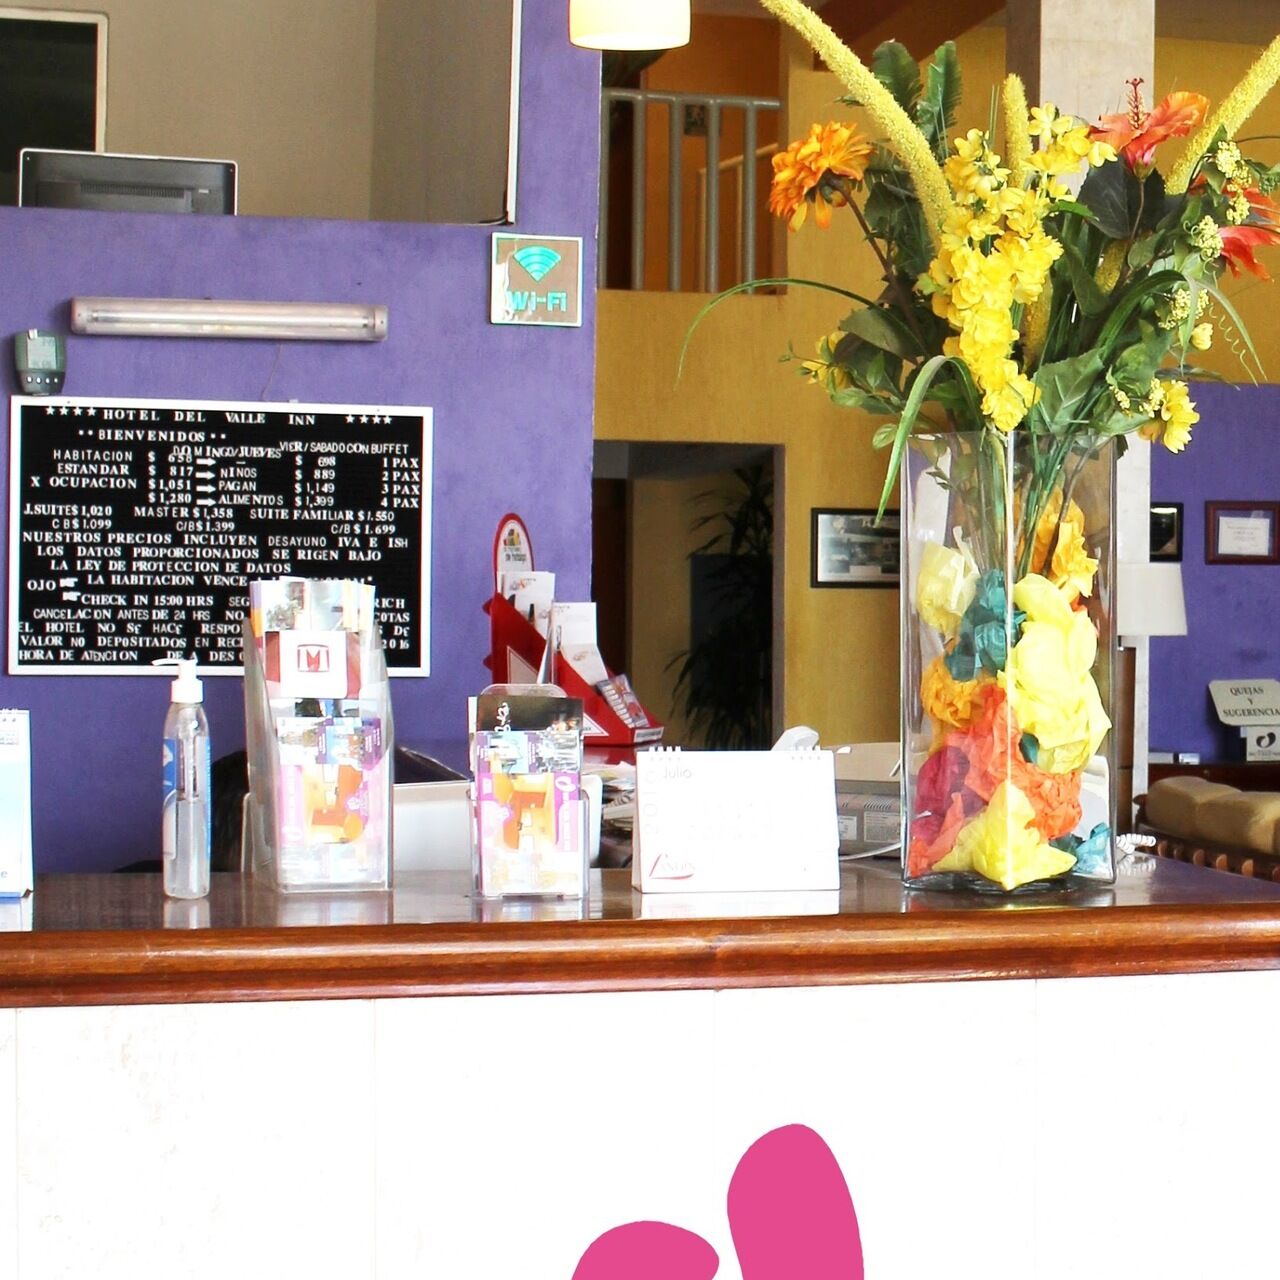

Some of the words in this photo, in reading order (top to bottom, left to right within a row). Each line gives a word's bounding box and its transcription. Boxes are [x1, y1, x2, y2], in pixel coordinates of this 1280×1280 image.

[104, 408, 159, 420] HOTEL
[175, 411, 205, 422] DEL
[226, 411, 265, 423] VALLE
[289, 414, 314, 425] INN
[368, 444, 408, 454] BUFFET
[54, 450, 132, 461] HABITACION
[393, 458, 418, 468] PAX
[58, 463, 129, 475] ESTANDAR
[170, 466, 193, 476] 817
[314, 470, 335, 479] 889
[382, 471, 388, 481] 2
[393, 471, 419, 481] PAX
[32, 476, 40, 487] X
[50, 477, 136, 488] OCUPACION
[219, 481, 256, 491] PAGAN
[382, 484, 388, 494] 3
[393, 485, 419, 495] PAX
[219, 494, 283, 505] ALIMENTOS
[381, 497, 388, 507] 4
[394, 498, 418, 508] PAX
[135, 507, 189, 517] MASTER
[251, 508, 288, 519] SUITE
[294, 510, 353, 520] FAMILIAR
[23, 531, 101, 542] NUESTROS
[108, 533, 171, 544] PRECIOS
[184, 534, 256, 545] INCLUYEN
[269, 536, 326, 547] DESAYUNO
[339, 537, 360, 547] IVA
[370, 537, 377, 547] E
[389, 538, 408, 547] ISH
[38, 546, 63, 556] LOS
[78, 546, 121, 557] DATOS
[134, 547, 259, 559] PROPORCIONADOS
[273, 549, 289, 559] SE
[298, 549, 338, 560] RIGEN
[349, 550, 381, 561] BAJO
[51, 560, 68, 570] LA
[77, 560, 101, 571] LEY
[109, 560, 126, 571] DE
[133, 561, 219, 572] PROTECCION
[226, 562, 238, 573] DE
[247, 563, 291, 573] DATOS
[27, 580, 56, 590] OJO
[88, 574, 104, 584] LA
[112, 575, 194, 585] HABITACION
[204, 575, 247, 586] VENCE
[81, 594, 127, 606] CHECK
[134, 595, 148, 605] IN
[155, 595, 183, 606] 15:00
[187, 596, 213, 606] HRS
[229, 596, 250, 607] SEG
[118, 609, 149, 620] ANTES
[152, 609, 168, 620] DE
[174, 610, 185, 620] 24
[193, 611, 210, 620] HRS
[46, 622, 84, 633] HOTEL
[98, 623, 115, 632] NO
[201, 624, 242, 635] RESPO
[20, 635, 63, 646] VALOR
[195, 637, 209, 647] EN
[18, 650, 54, 660] HORA
[60, 650, 73, 660] DE
[1230, 686, 1264, 696] QUEJAS
